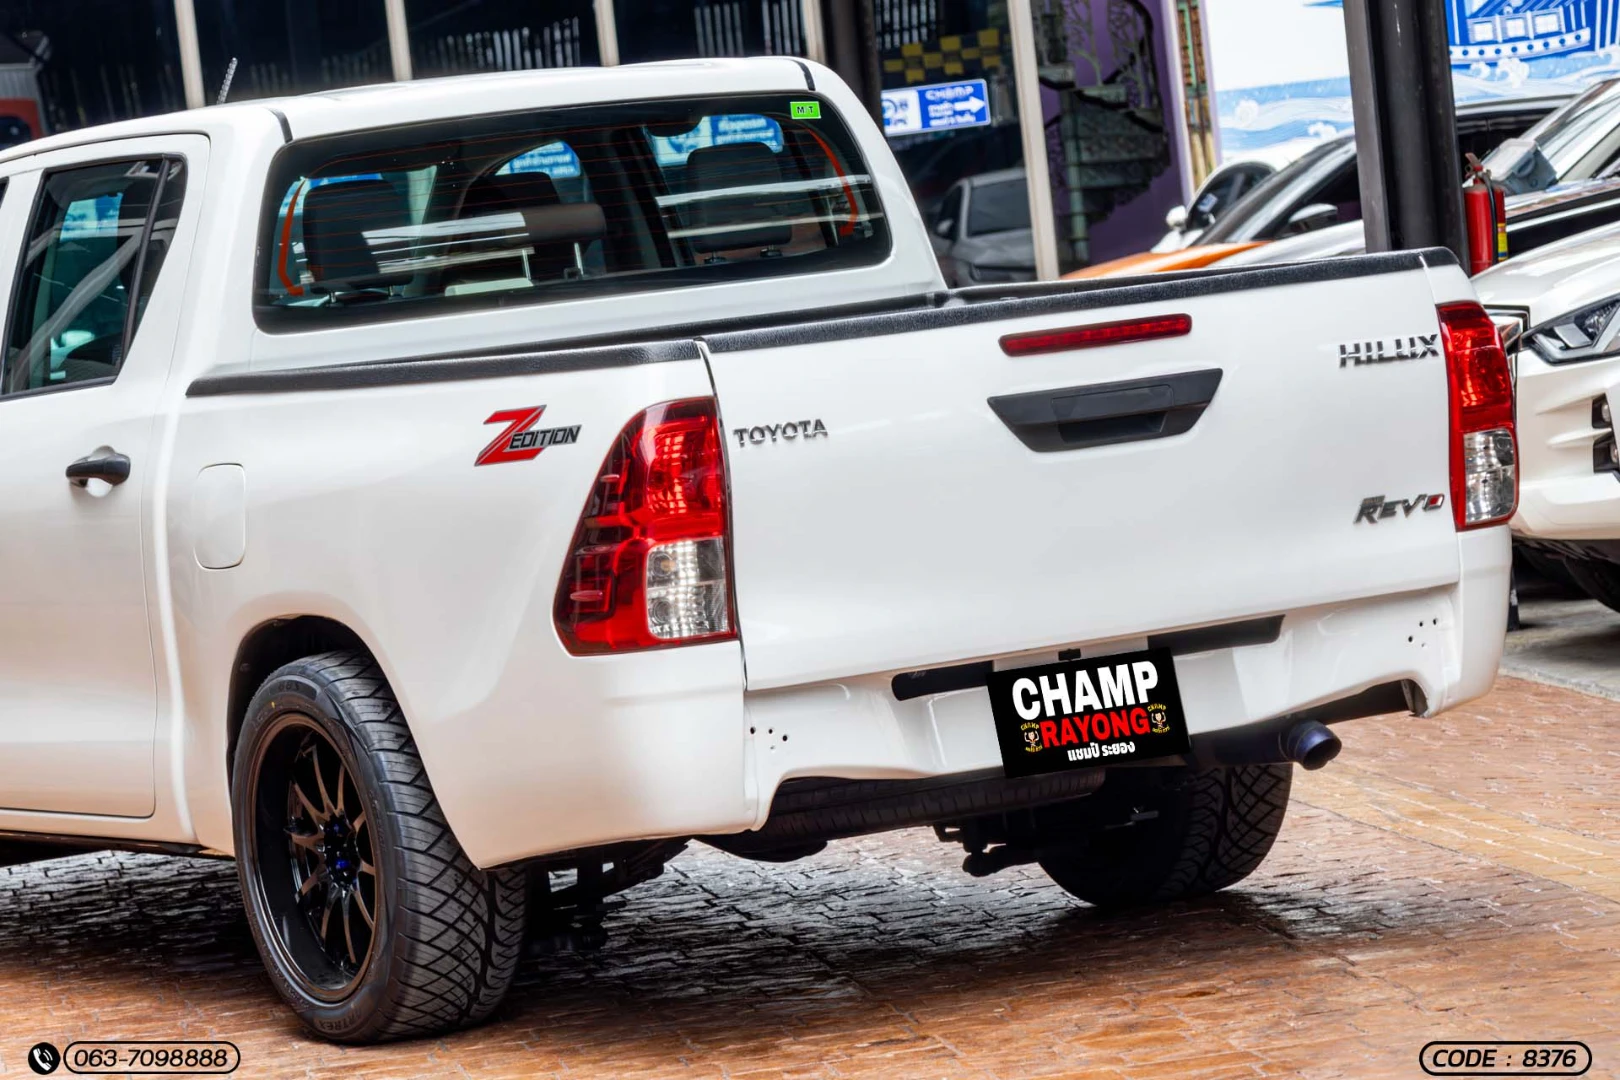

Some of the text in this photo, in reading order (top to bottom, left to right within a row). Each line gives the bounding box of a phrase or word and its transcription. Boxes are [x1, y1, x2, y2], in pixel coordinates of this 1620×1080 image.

[1338, 334, 1439, 368] HILUX
[509, 425, 582, 449] EDITION
[734, 418, 828, 447] TOYOTA
[1012, 660, 1158, 721] CHAMP
[1040, 707, 1151, 748] RAYONG
[1101, 741, 1136, 757] ระยอง
